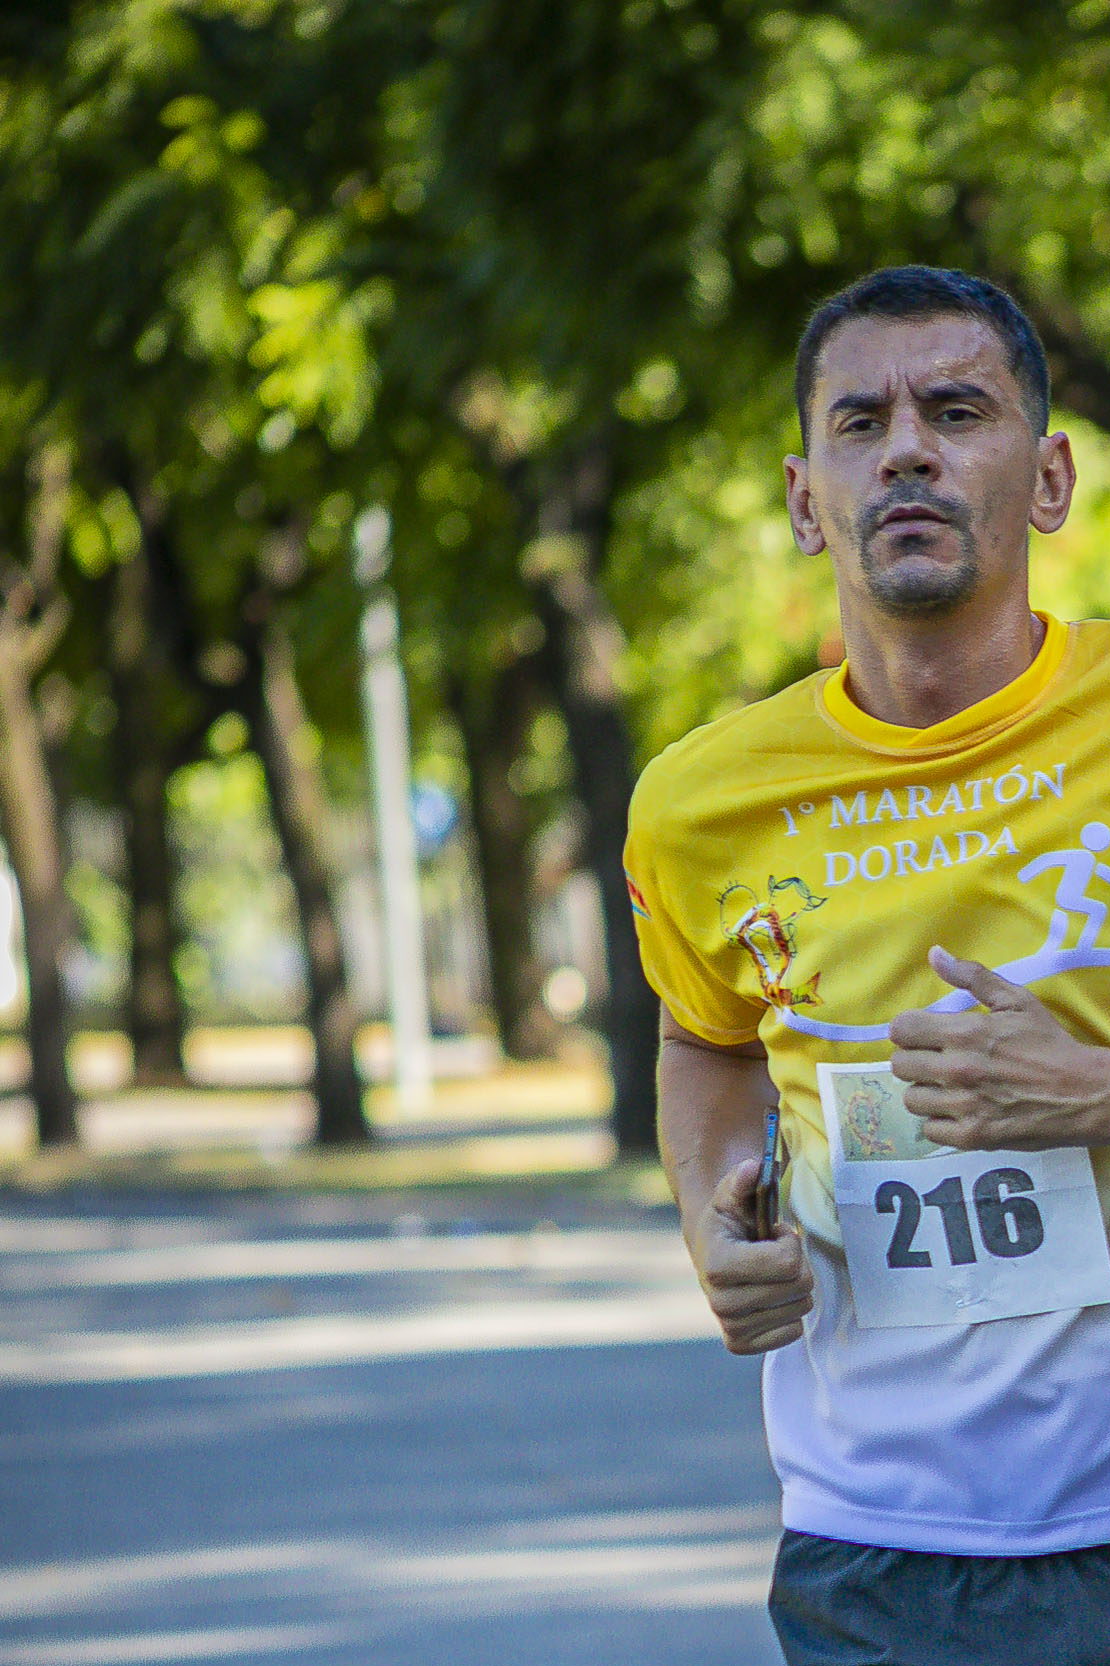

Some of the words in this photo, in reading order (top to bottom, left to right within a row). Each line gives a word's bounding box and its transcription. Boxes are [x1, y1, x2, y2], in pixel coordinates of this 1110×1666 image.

[829, 763, 1067, 828] MARATÓN
[823, 826, 1020, 887] DORADA
[874, 1167, 1045, 1269] 216
